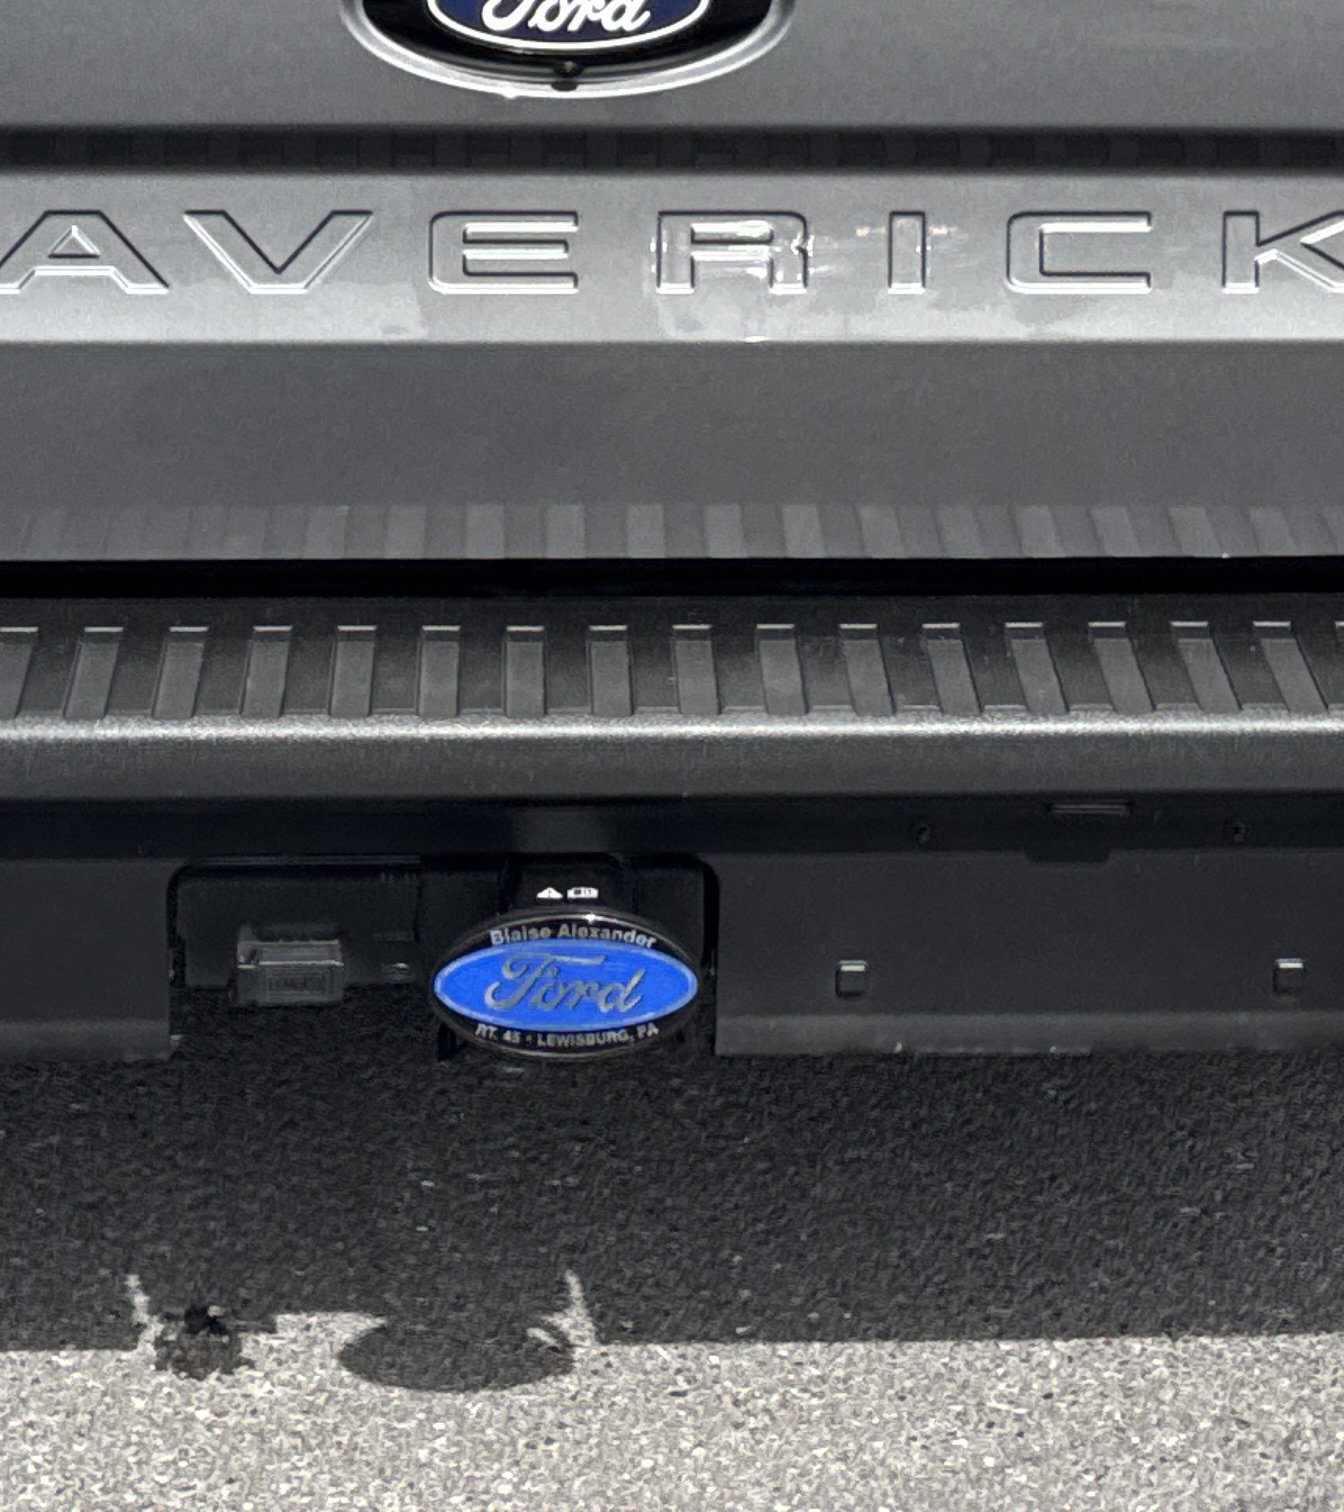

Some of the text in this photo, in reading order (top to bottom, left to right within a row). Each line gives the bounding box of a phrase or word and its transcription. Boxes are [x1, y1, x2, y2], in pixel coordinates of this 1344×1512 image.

[490, 922, 658, 949] Blaise Alexander
[483, 950, 647, 1013] Ford
[636, 1022, 660, 1040] PA
